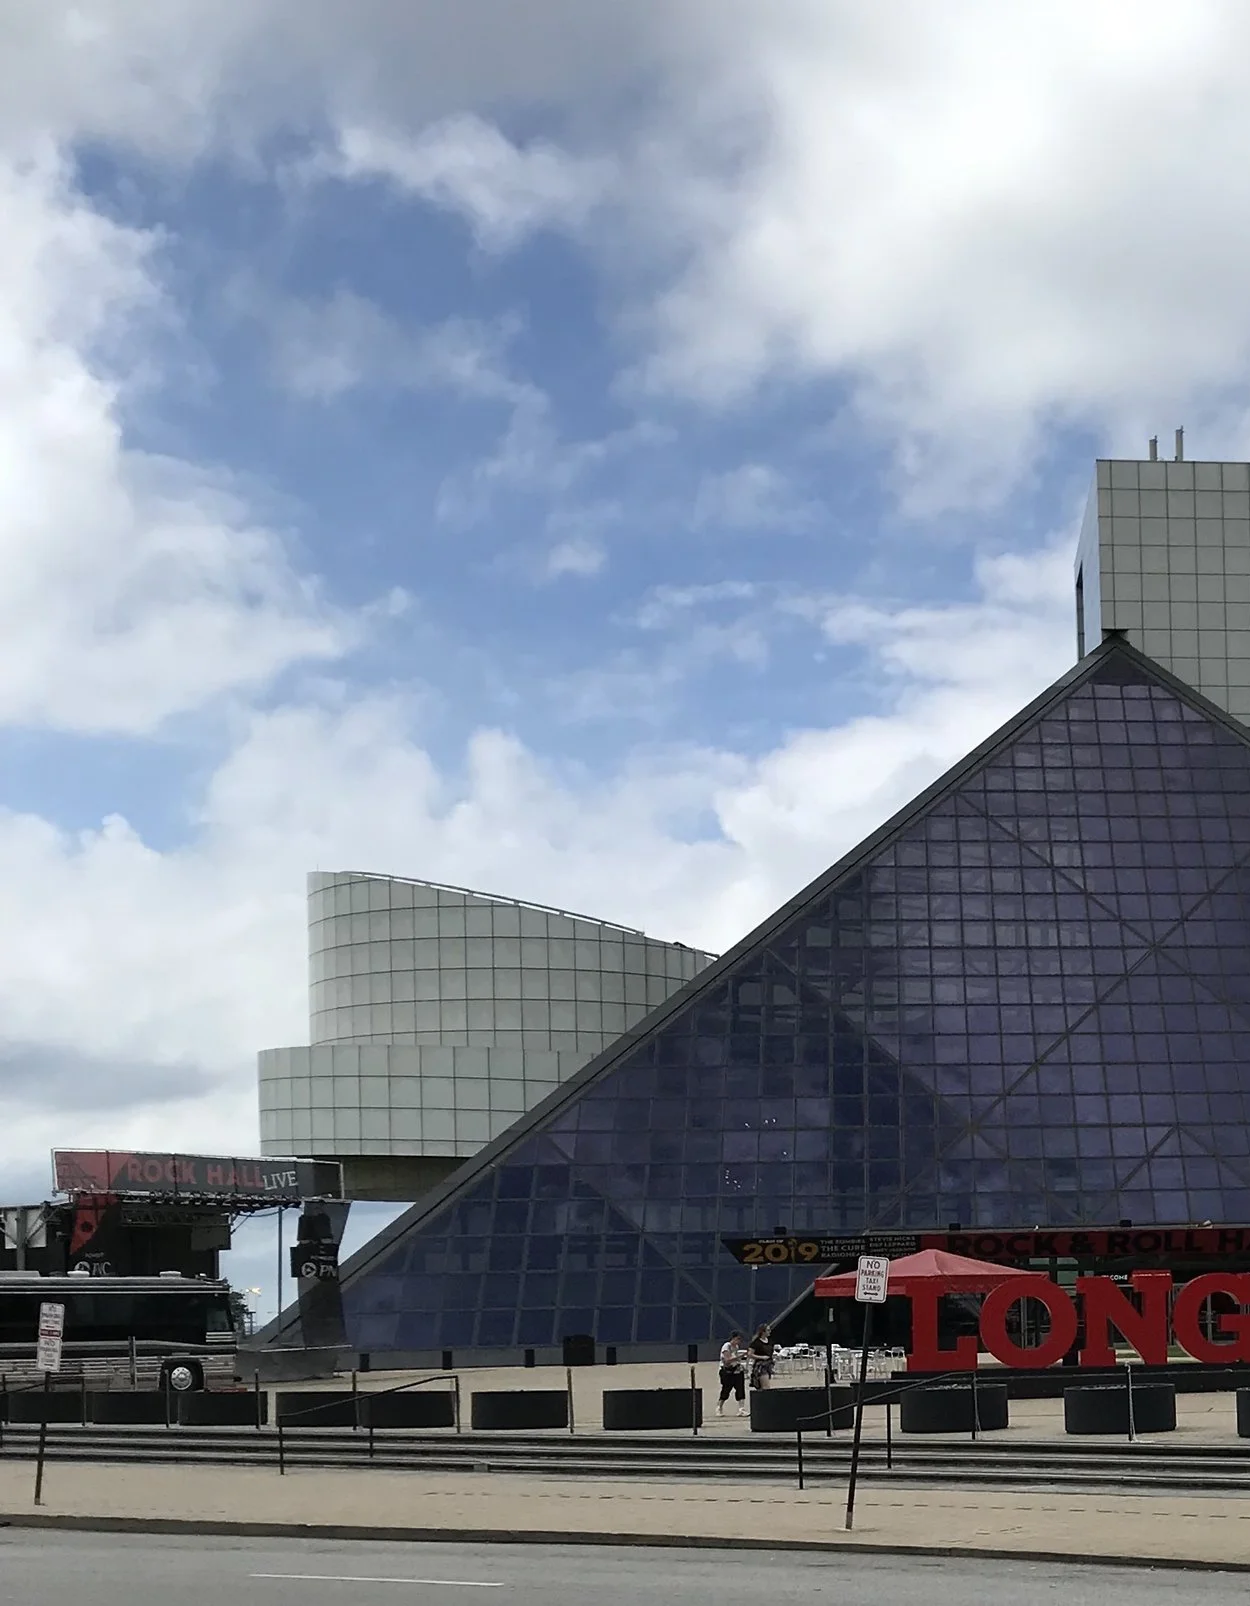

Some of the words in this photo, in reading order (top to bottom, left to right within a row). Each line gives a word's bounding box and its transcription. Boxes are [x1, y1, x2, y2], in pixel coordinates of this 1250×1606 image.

[127, 1159, 197, 1184] ROCK
[206, 1163, 264, 1188] HALL
[262, 1171, 298, 1190] LIVE
[946, 1233, 1059, 1257] ROCK
[1070, 1233, 1095, 1254] &
[1108, 1230, 1203, 1254] ROLL
[866, 1260, 881, 1269] NO
[861, 1269, 884, 1278] PARKING
[862, 1284, 881, 1292] STAND
